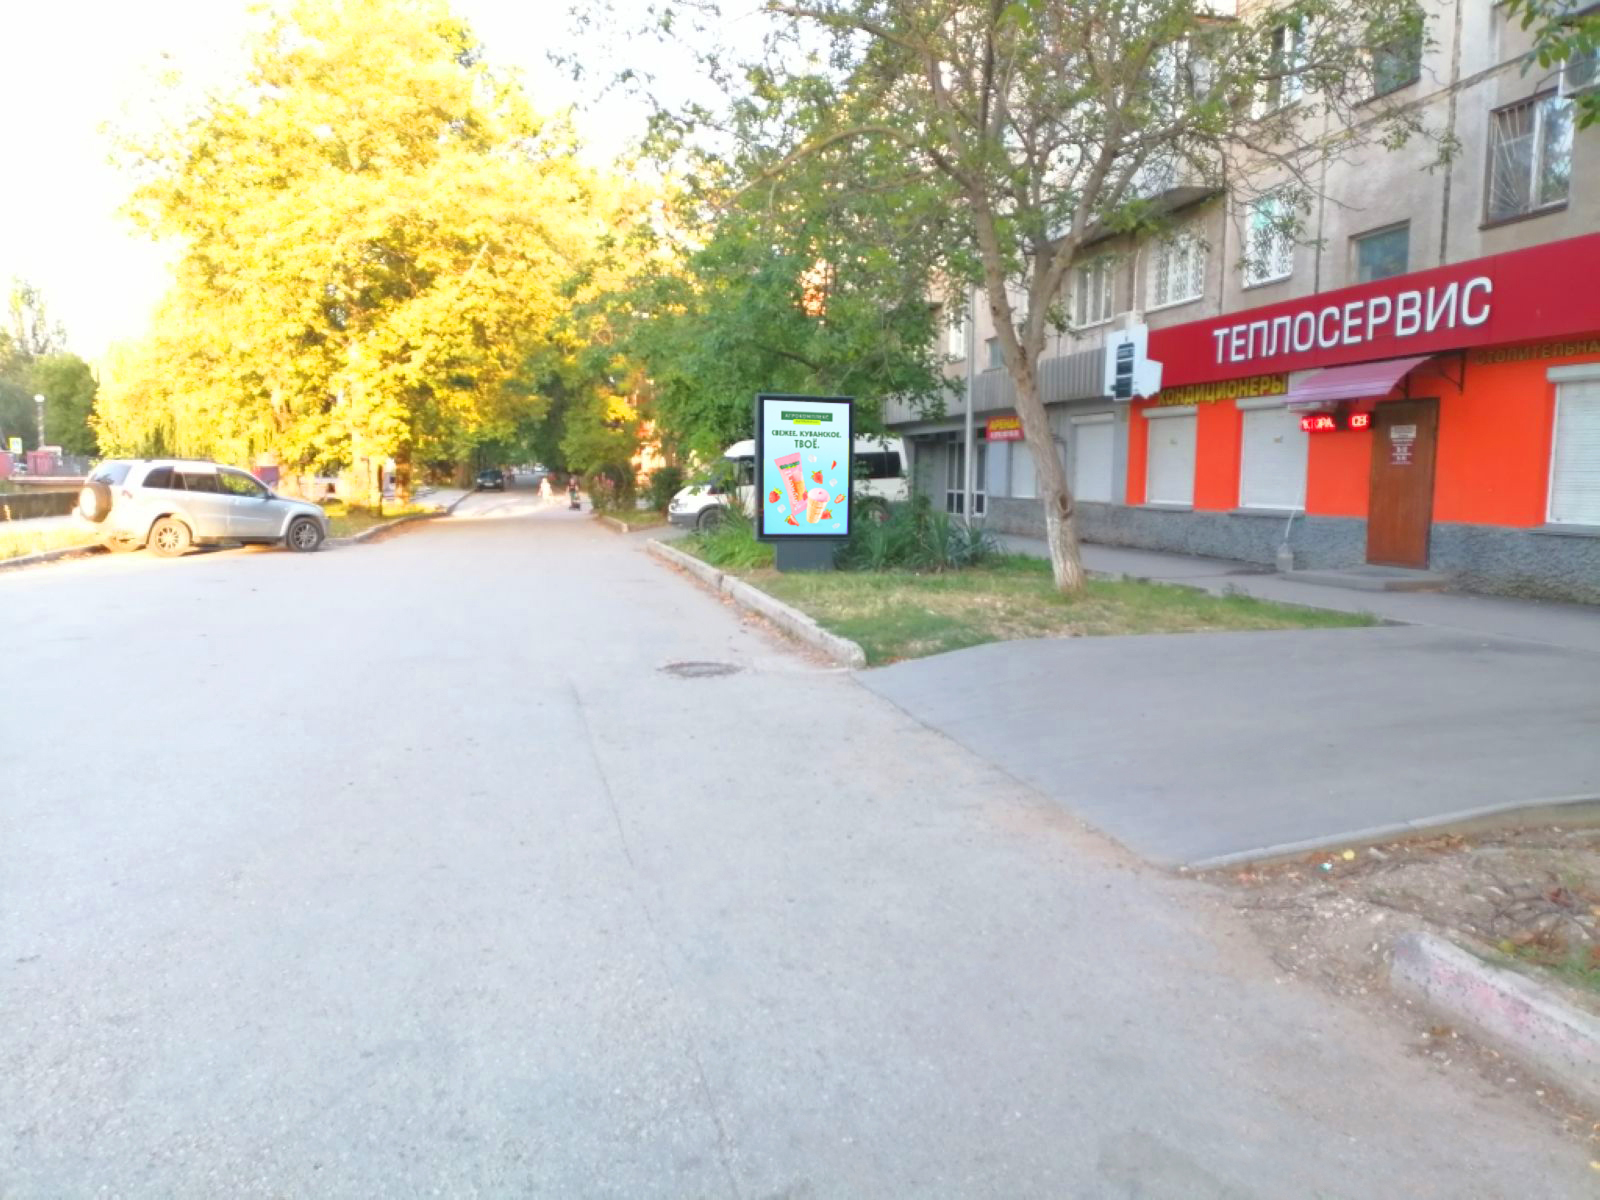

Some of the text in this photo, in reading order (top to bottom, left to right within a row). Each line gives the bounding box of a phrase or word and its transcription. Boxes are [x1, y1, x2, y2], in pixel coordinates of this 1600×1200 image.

[1212, 276, 1493, 364] ТЕПЛОСЕРВИС
[1159, 374, 1287, 405] КОНДИЦИОНЕРЫ
[794, 438, 820, 449] ТВОЁ.
